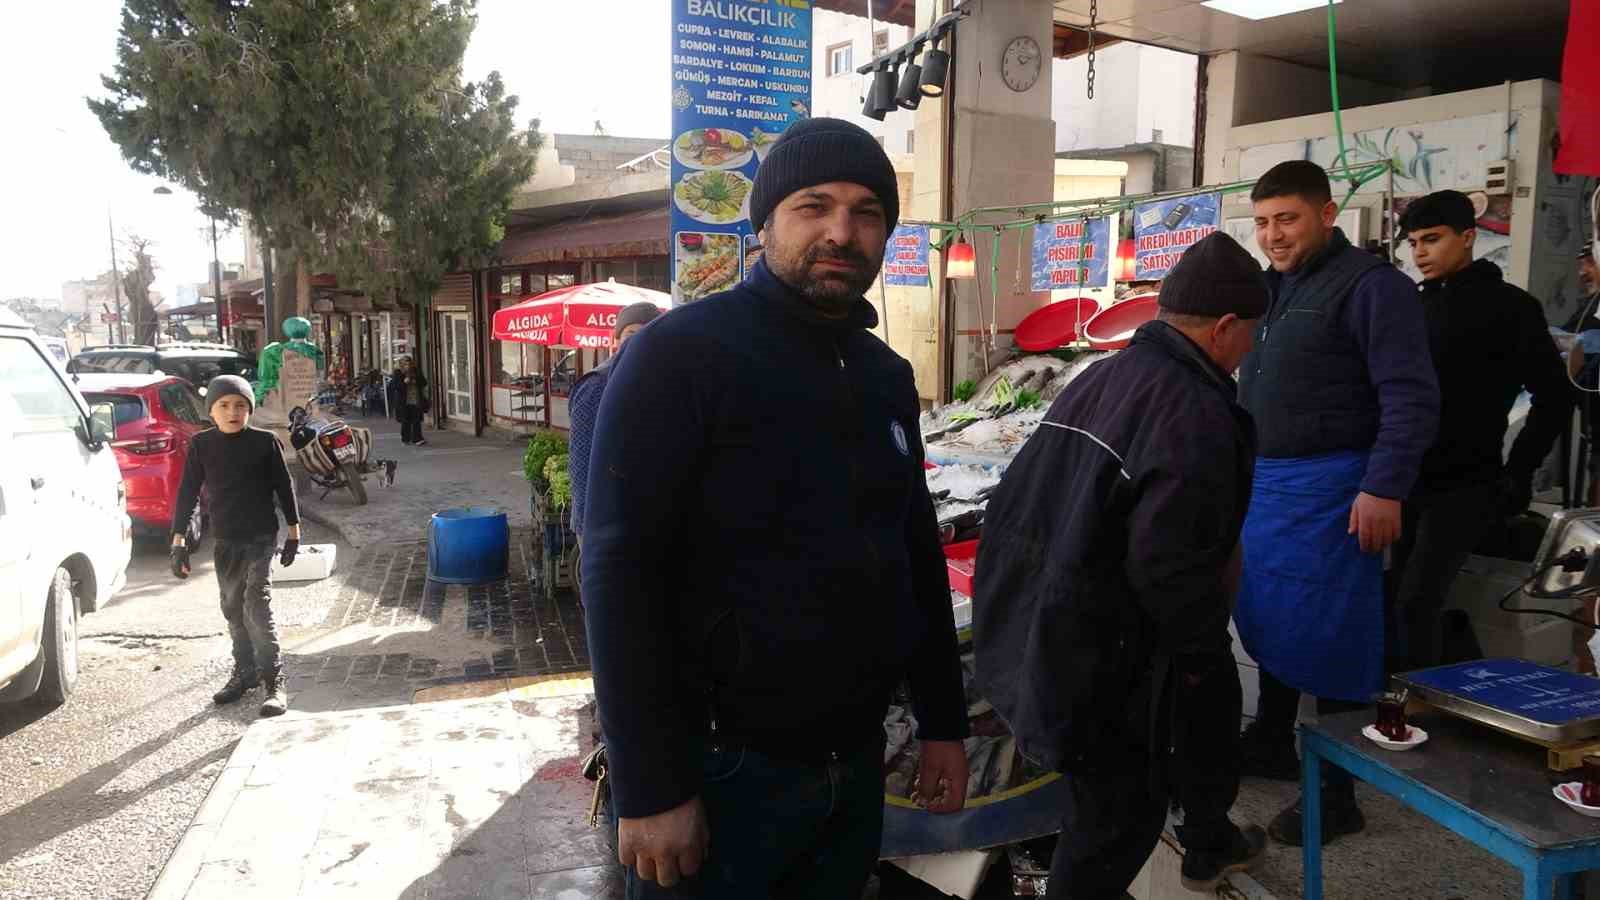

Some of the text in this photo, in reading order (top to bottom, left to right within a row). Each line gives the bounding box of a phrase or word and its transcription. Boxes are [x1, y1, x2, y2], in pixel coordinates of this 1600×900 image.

[687, 0, 797, 29] BALIKÇILIK
[718, 28, 755, 42] LEVREK
[762, 34, 808, 49] ALABALIK
[680, 39, 716, 52] SOMON
[760, 50, 805, 63] PALAMUT
[730, 62, 766, 74] LOKUM
[773, 66, 811, 79] BARBUN
[717, 75, 758, 89] MERCAN
[749, 95, 778, 106] KEFAL
[1050, 268, 1089, 284] YAPILR
[507, 313, 549, 331] ALGIDA
[586, 312, 617, 328] ALG
